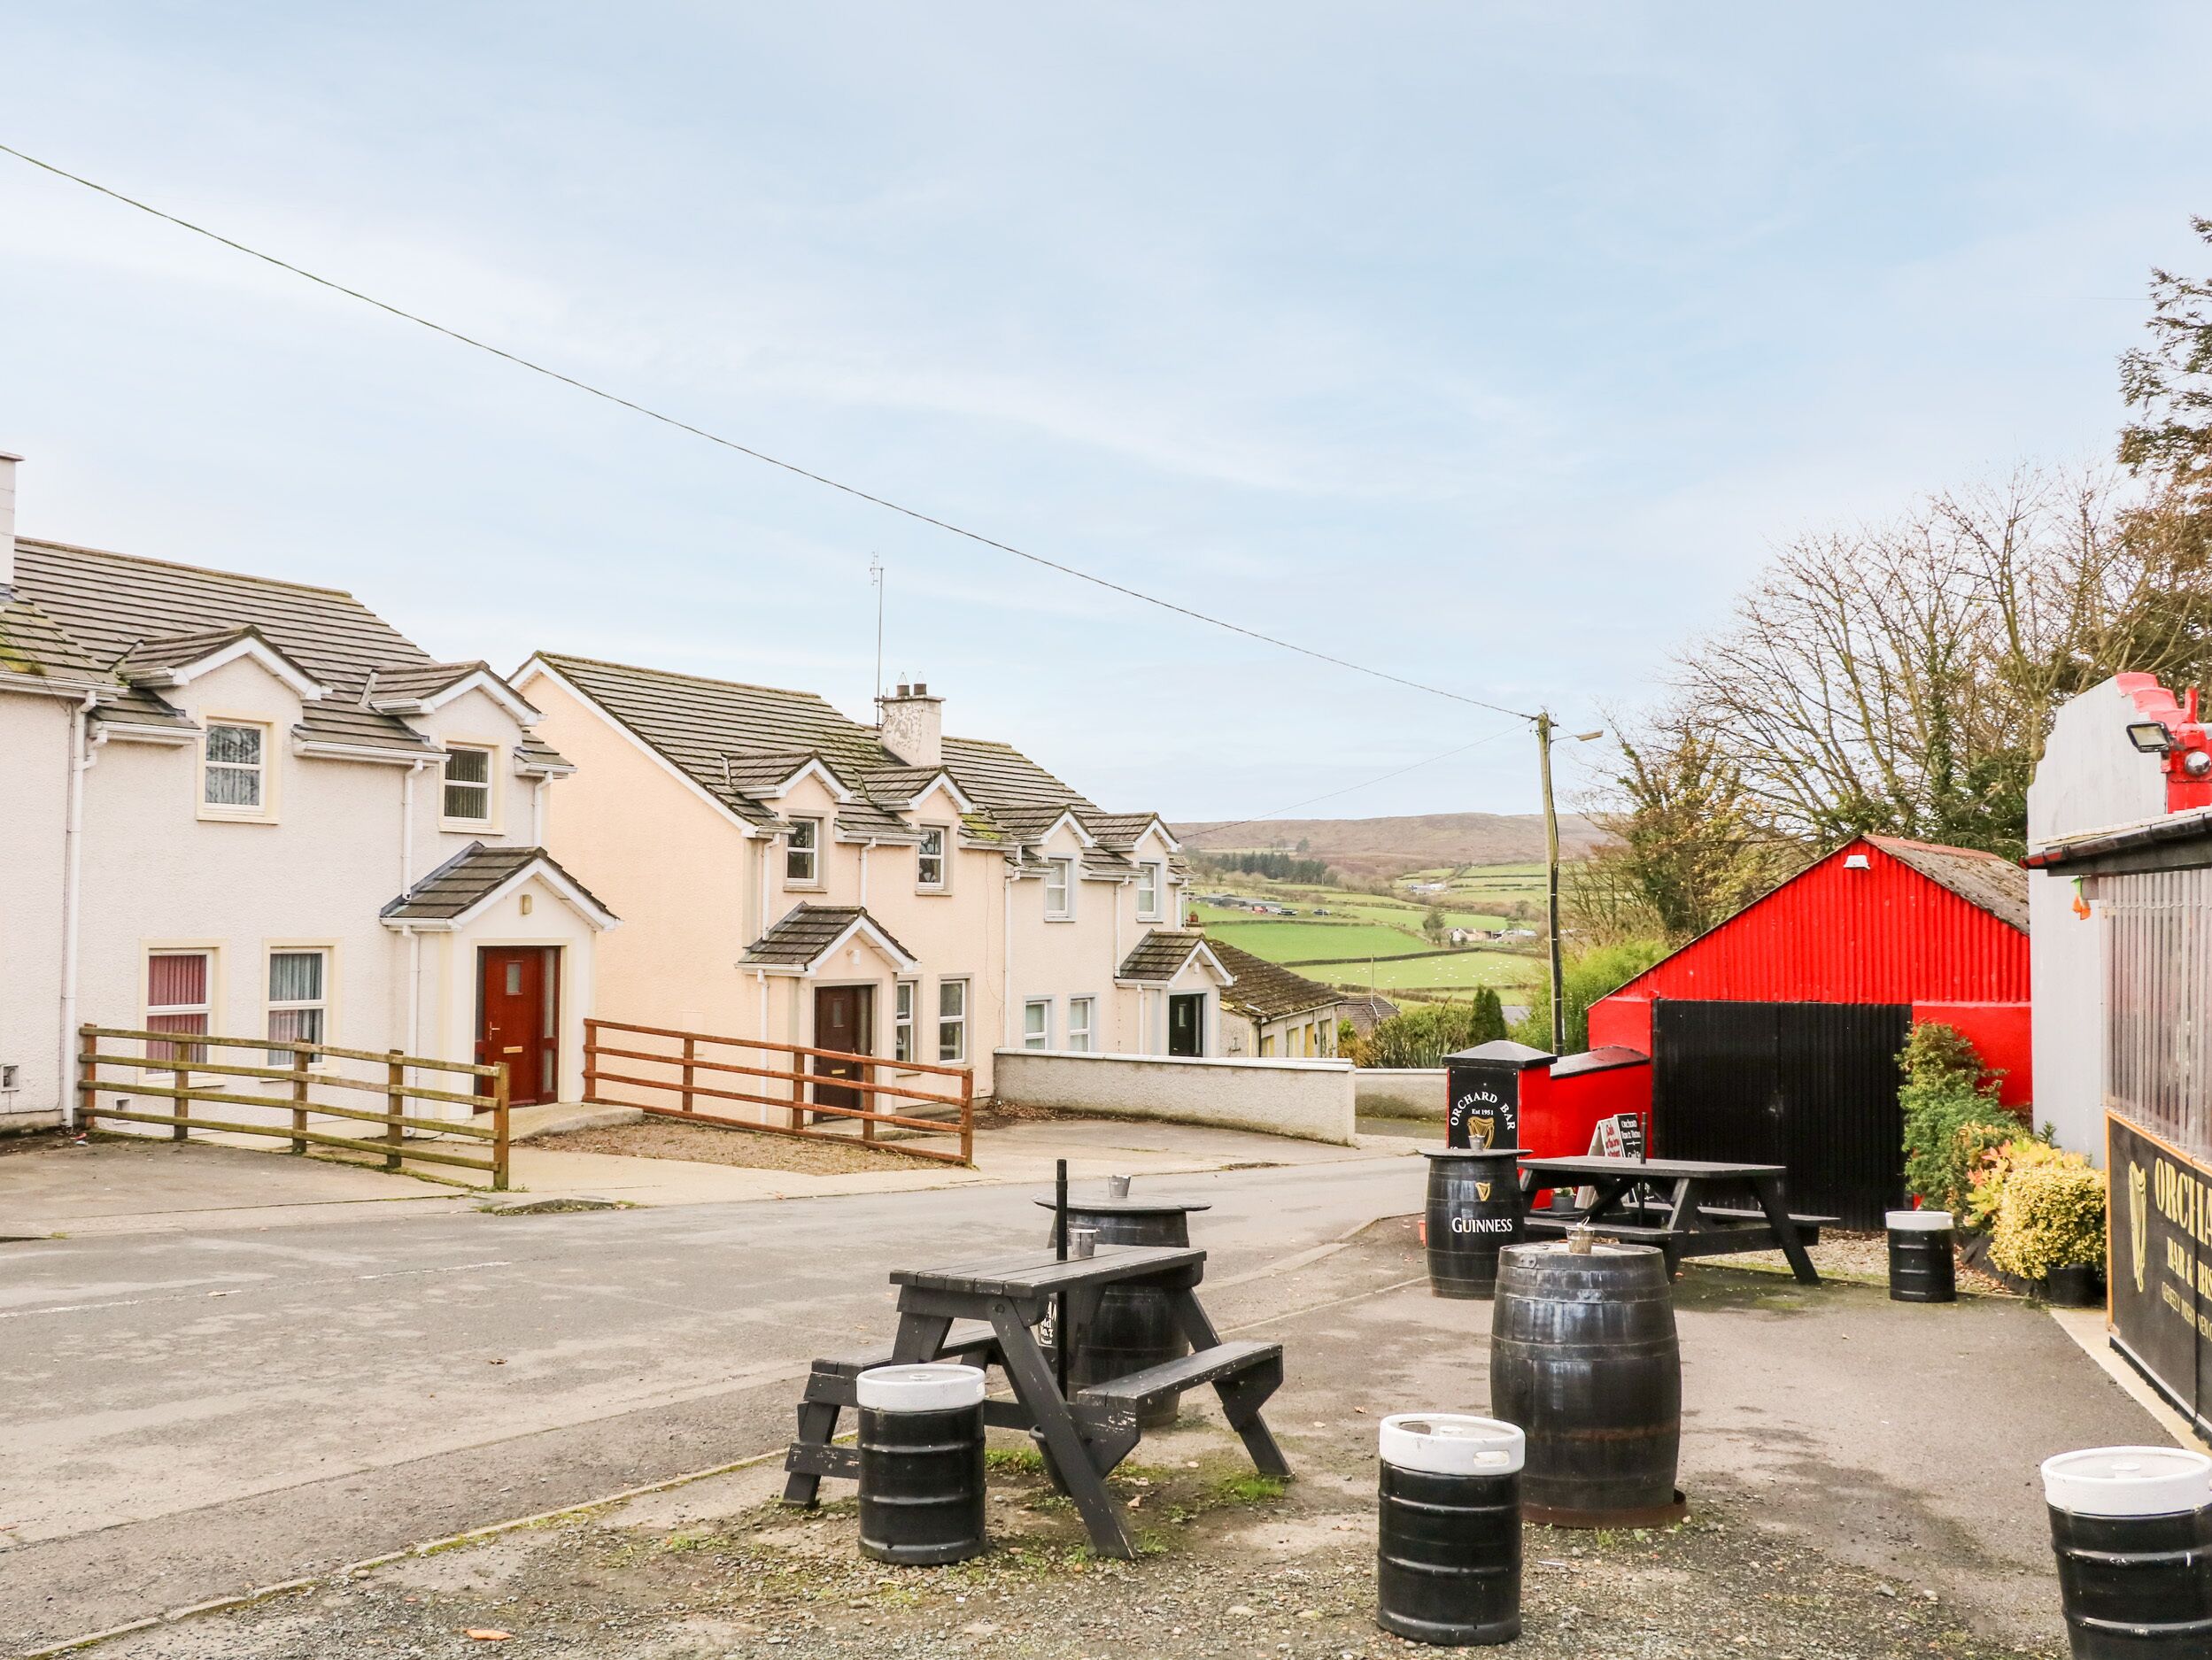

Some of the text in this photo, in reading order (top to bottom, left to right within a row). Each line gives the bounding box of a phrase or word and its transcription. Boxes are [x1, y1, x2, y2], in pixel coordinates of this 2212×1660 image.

[1450, 1091, 1516, 1131] ORCHARD BAR
[1451, 1216, 1513, 1233] GUINNESS
[2167, 1236, 2185, 1279] BAR
[2186, 1253, 2194, 1288] &
